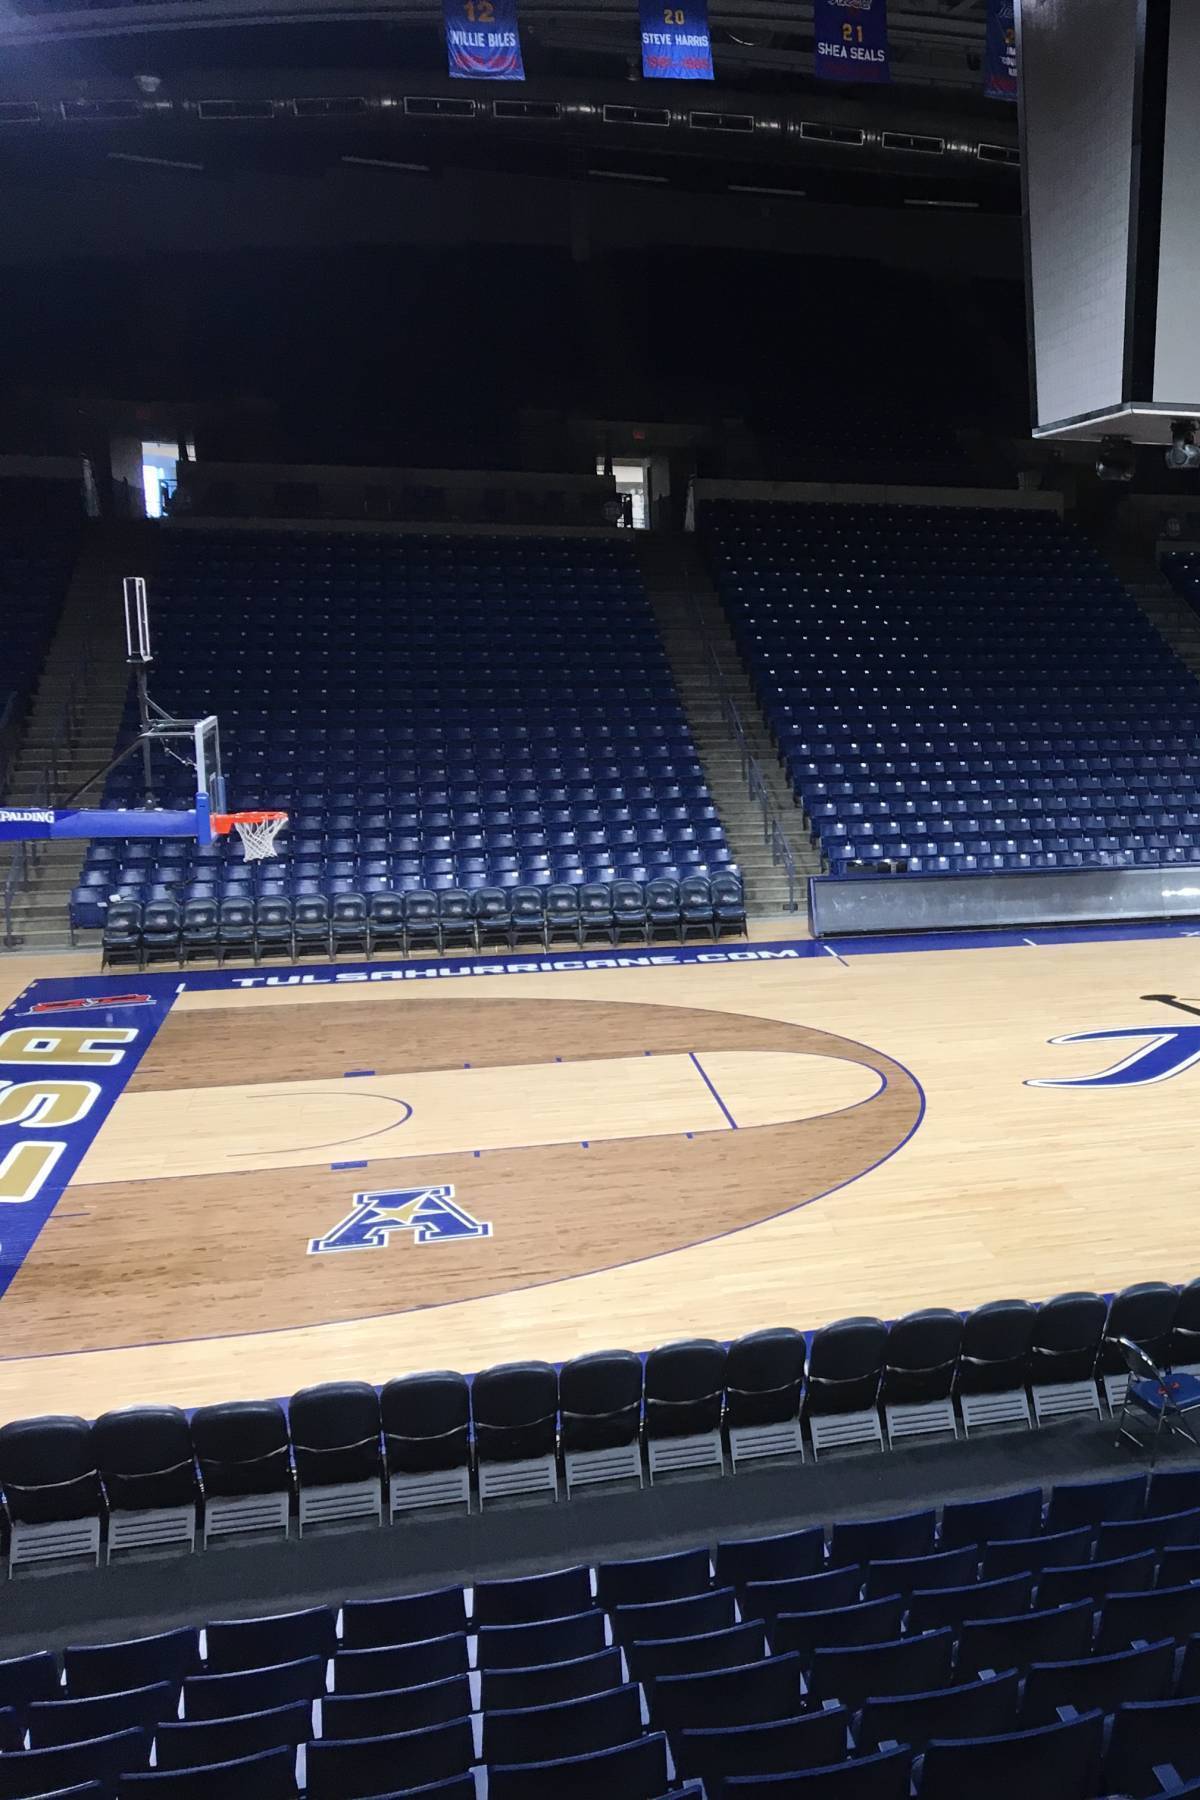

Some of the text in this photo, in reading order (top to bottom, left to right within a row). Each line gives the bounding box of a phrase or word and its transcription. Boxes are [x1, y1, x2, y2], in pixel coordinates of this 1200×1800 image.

[464, 1, 495, 21] 12
[664, 9, 684, 24] 20
[488, 32, 516, 47] BILES
[642, 32, 709, 47] STEVE HARRIS
[842, 23, 863, 42] 21
[817, 42, 885, 62] SHEA SEALS
[232, 949, 799, 987] TULSAHURRICANE.COM
